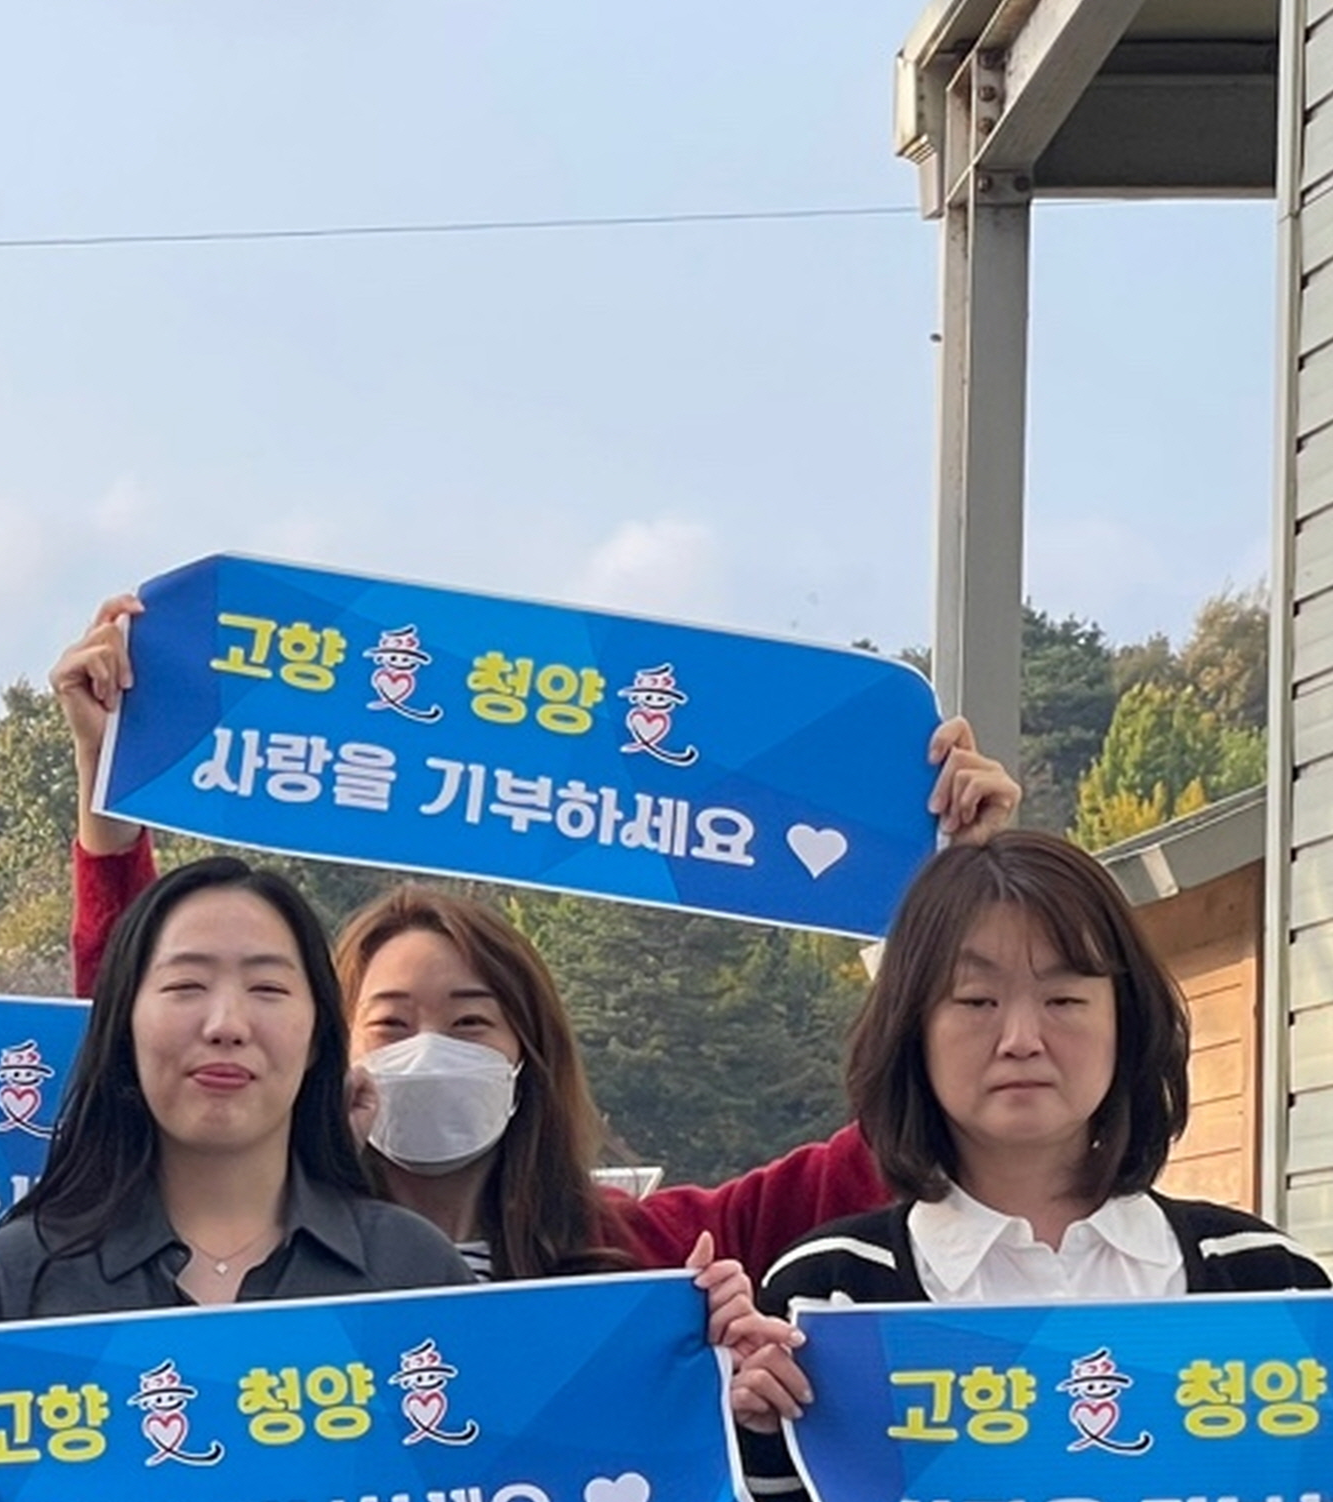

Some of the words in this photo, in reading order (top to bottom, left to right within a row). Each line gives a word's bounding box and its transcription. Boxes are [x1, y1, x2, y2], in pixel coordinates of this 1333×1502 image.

[211, 615, 347, 691] 고향
[469, 653, 606, 734] 청양
[194, 728, 397, 811] 사랑을
[419, 756, 755, 867] 기부하세요
[239, 1364, 376, 1445] 청양
[889, 1368, 1037, 1444] 고향
[1177, 1360, 1328, 1439] 청양
